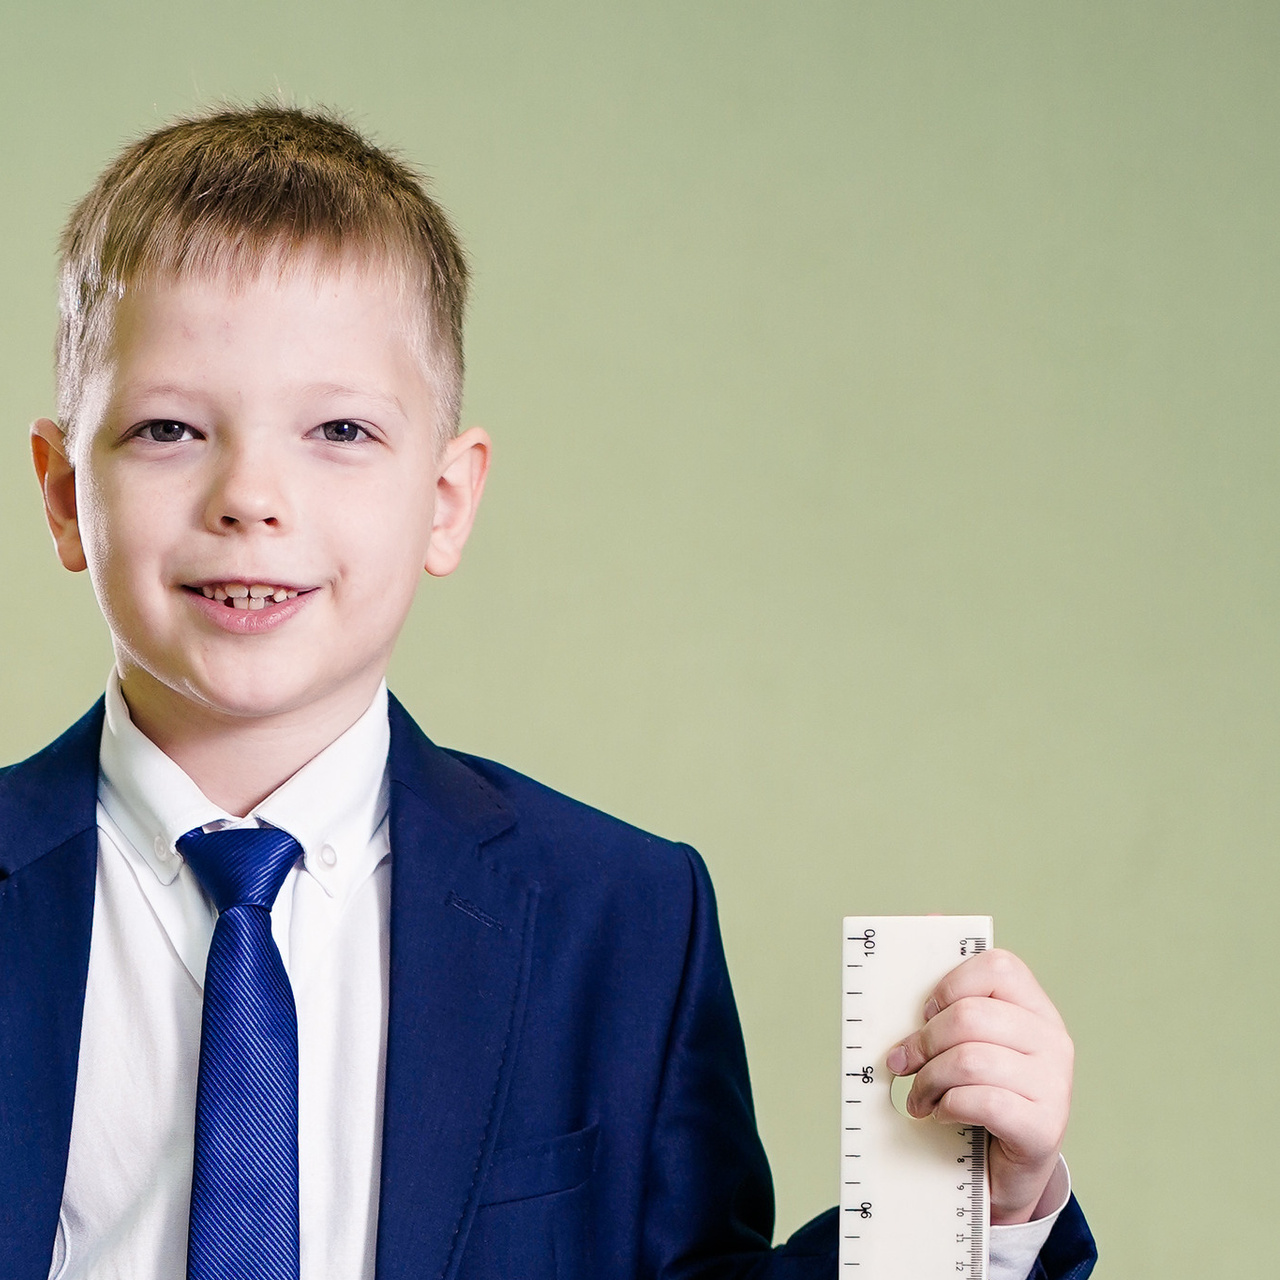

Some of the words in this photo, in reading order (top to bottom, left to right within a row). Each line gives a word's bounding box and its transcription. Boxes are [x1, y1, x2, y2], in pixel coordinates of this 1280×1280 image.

[864, 929, 875, 957] 100
[862, 1066, 873, 1083] 95
[861, 1202, 872, 1218] 90
[956, 1207, 964, 1217] 10
[956, 1234, 963, 1242] 11
[956, 1261, 963, 1271] 12
